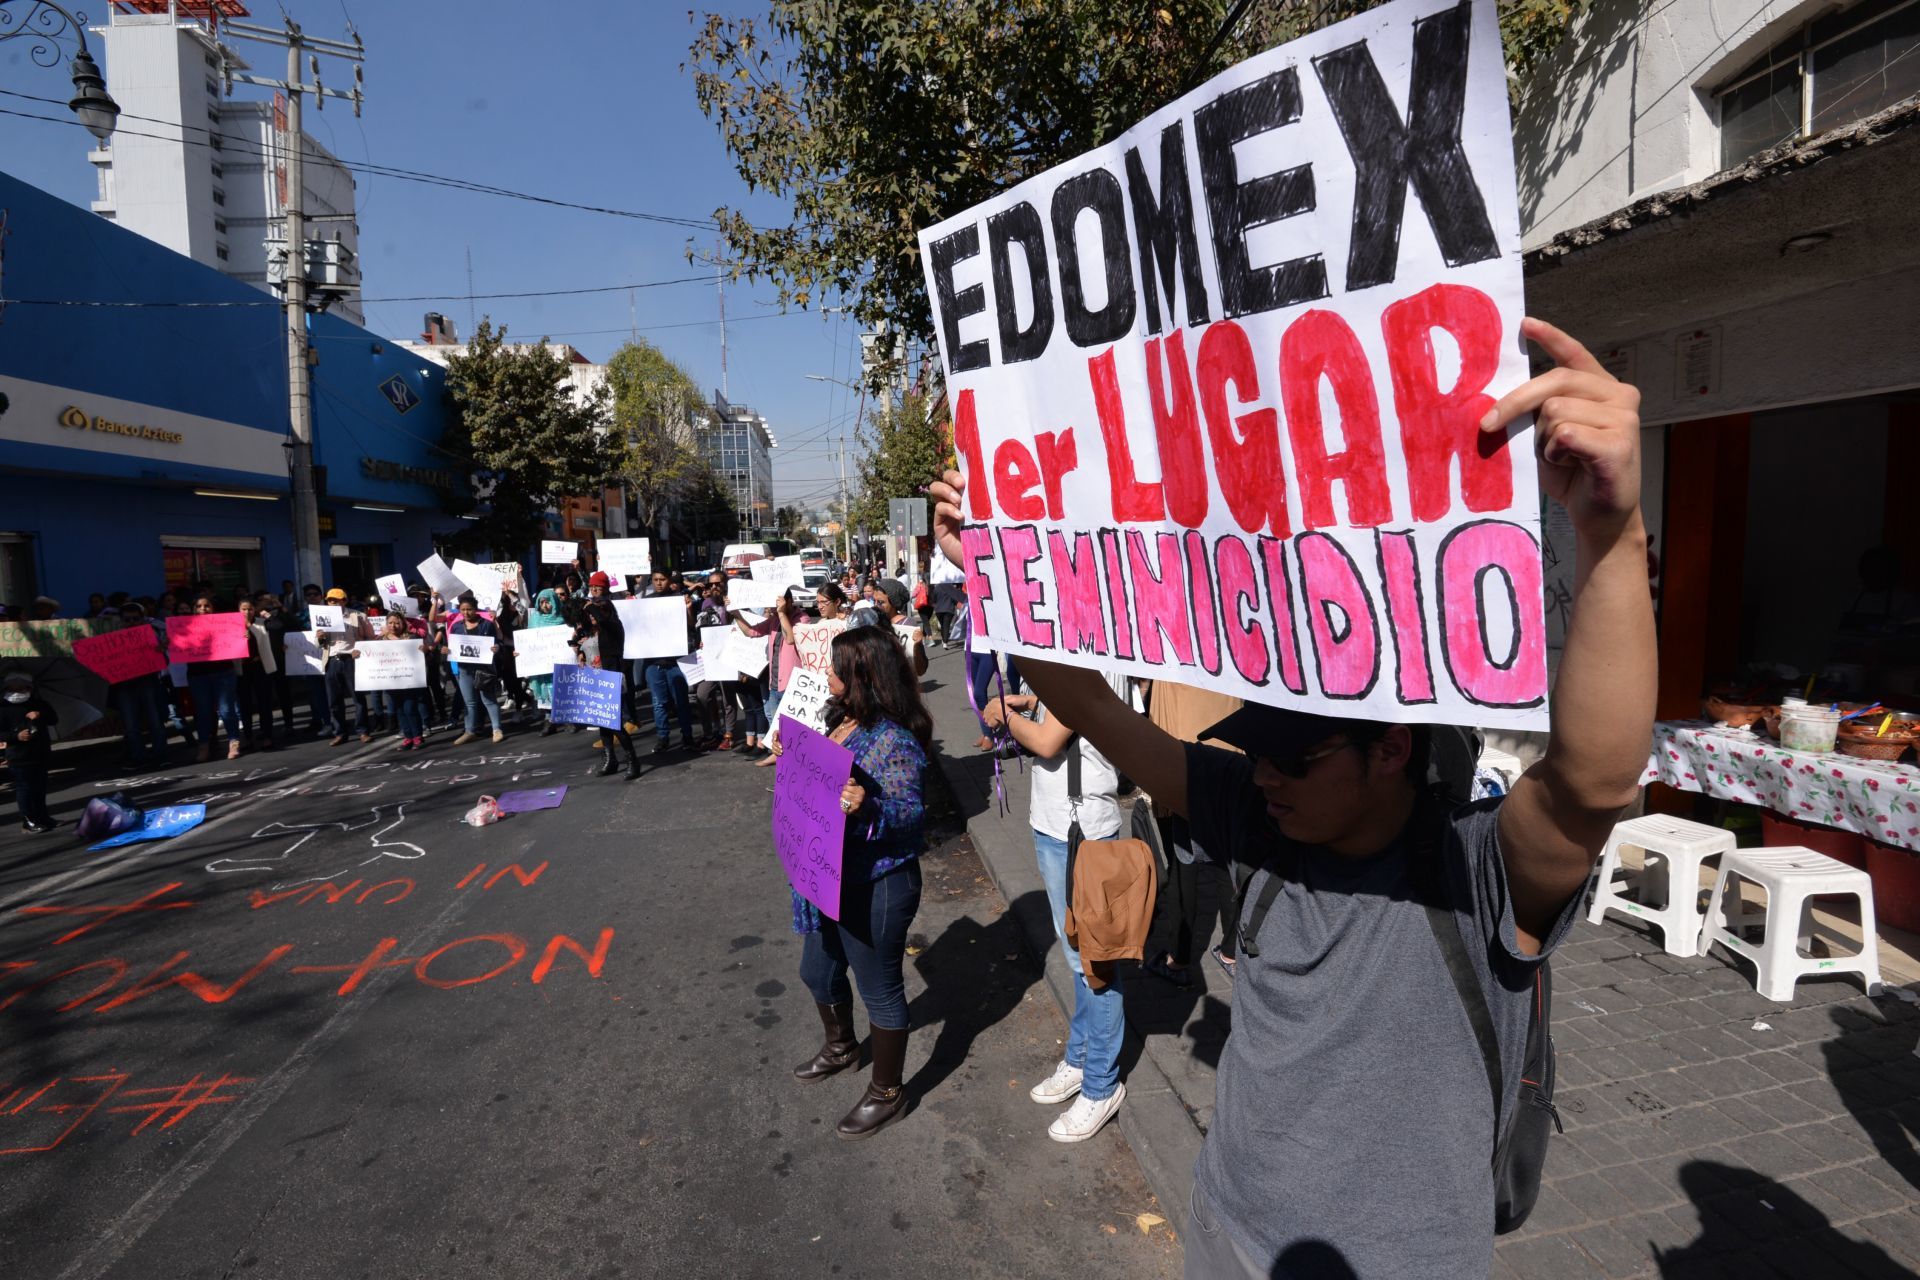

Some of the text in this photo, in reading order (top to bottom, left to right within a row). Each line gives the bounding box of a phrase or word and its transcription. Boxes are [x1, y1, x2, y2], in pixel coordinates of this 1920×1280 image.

[929, 0, 1503, 375] EDOMEX
[955, 283, 1514, 540] 1er LUGAR
[95, 416, 185, 443] Banco Azteca
[960, 519, 1546, 708] FEMINICIDIO
[797, 674, 830, 694] GRIT
[453, 861, 548, 890] NI
[245, 878, 416, 908] UNA
